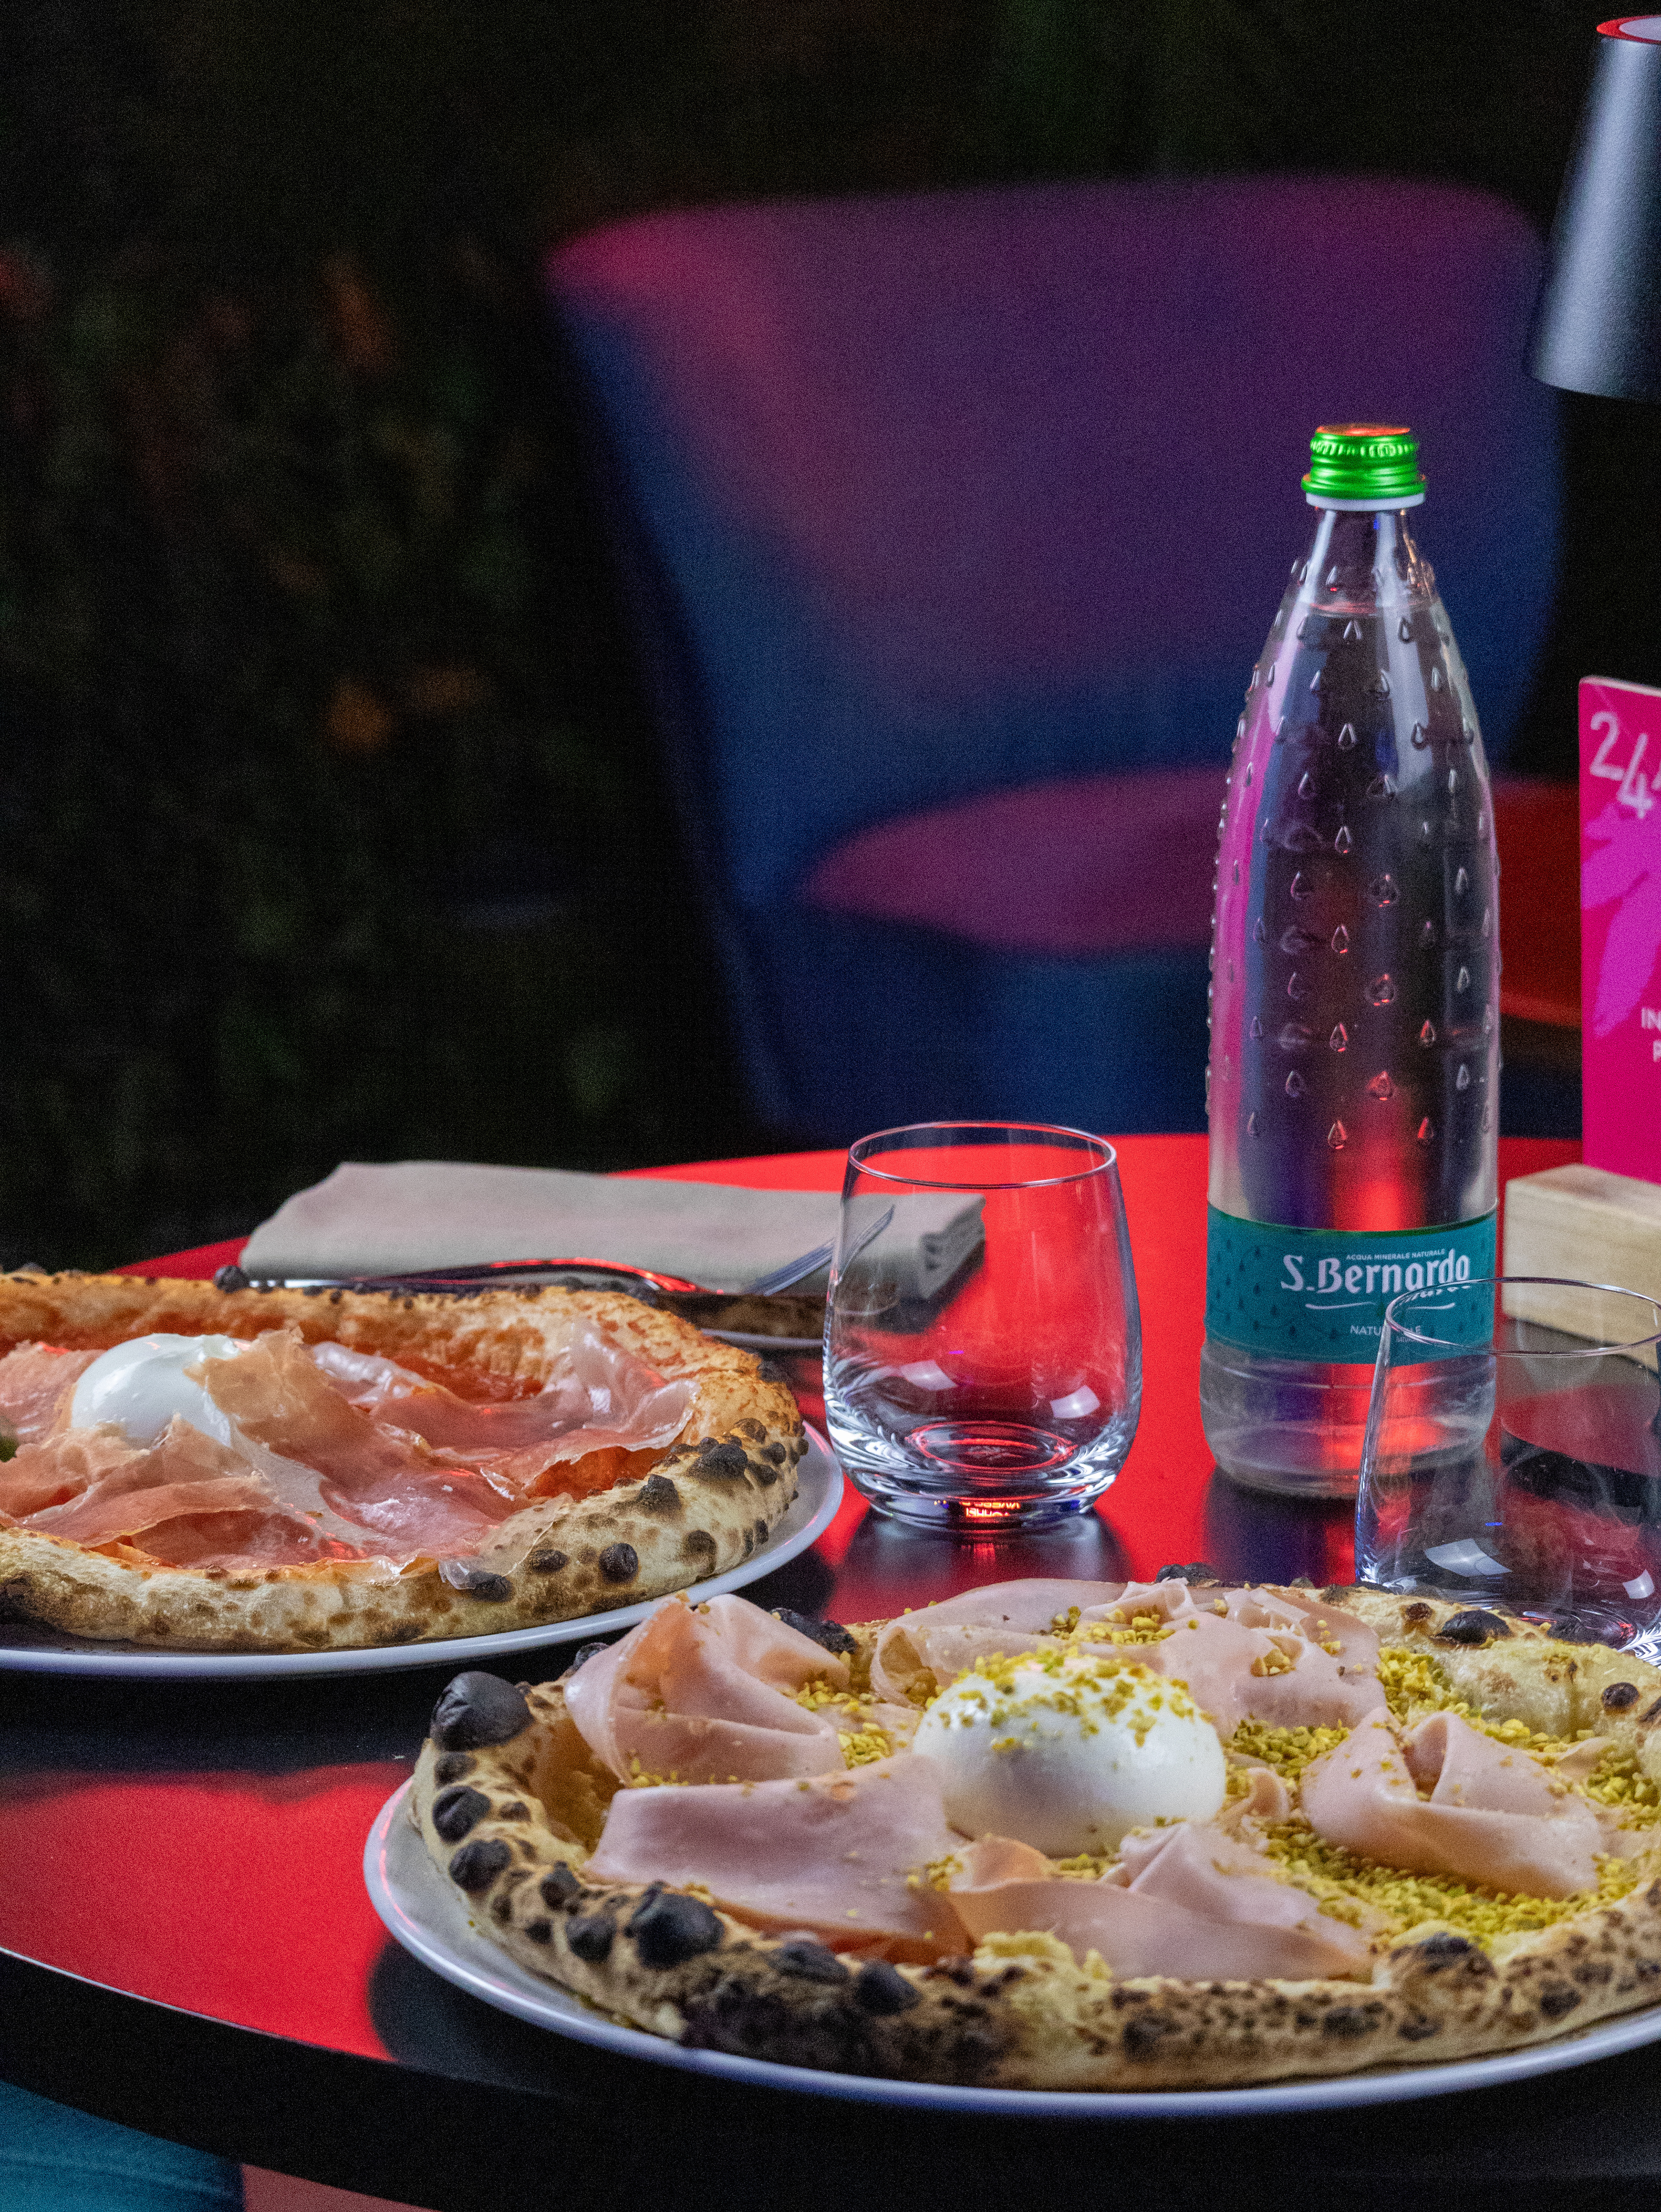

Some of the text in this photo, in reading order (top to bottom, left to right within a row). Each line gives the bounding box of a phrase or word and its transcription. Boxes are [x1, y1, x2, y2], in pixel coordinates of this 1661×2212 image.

[1589, 711, 1661, 818] 24
[1374, 1252, 1410, 1261] MINERALE
[1411, 1248, 1446, 1258] NATURALE
